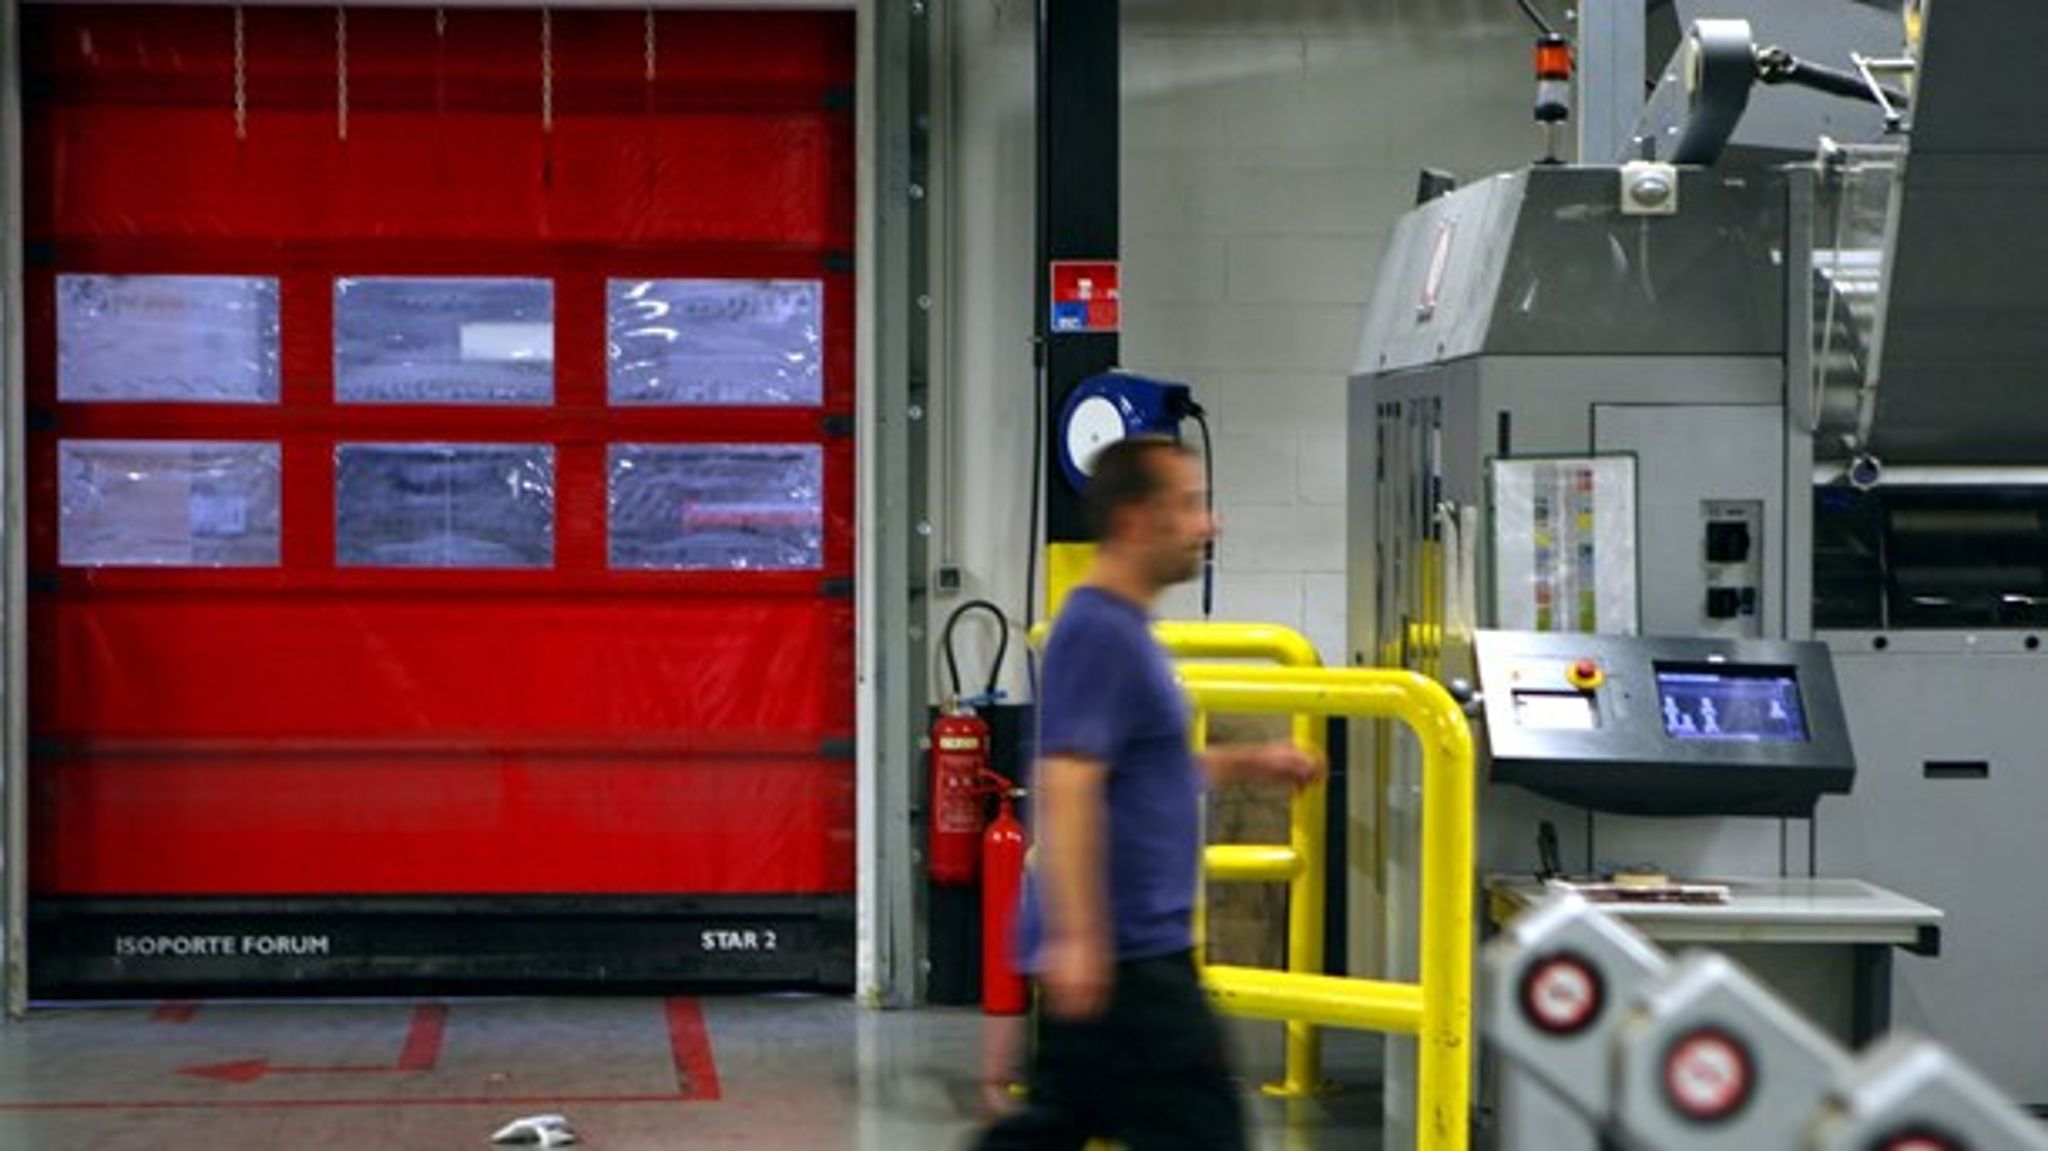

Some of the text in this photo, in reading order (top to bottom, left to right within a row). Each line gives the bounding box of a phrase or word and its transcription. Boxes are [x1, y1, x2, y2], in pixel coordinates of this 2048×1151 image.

[115, 934, 330, 955] ISOPORTE FORUM
[700, 929, 777, 951] STAR 2
